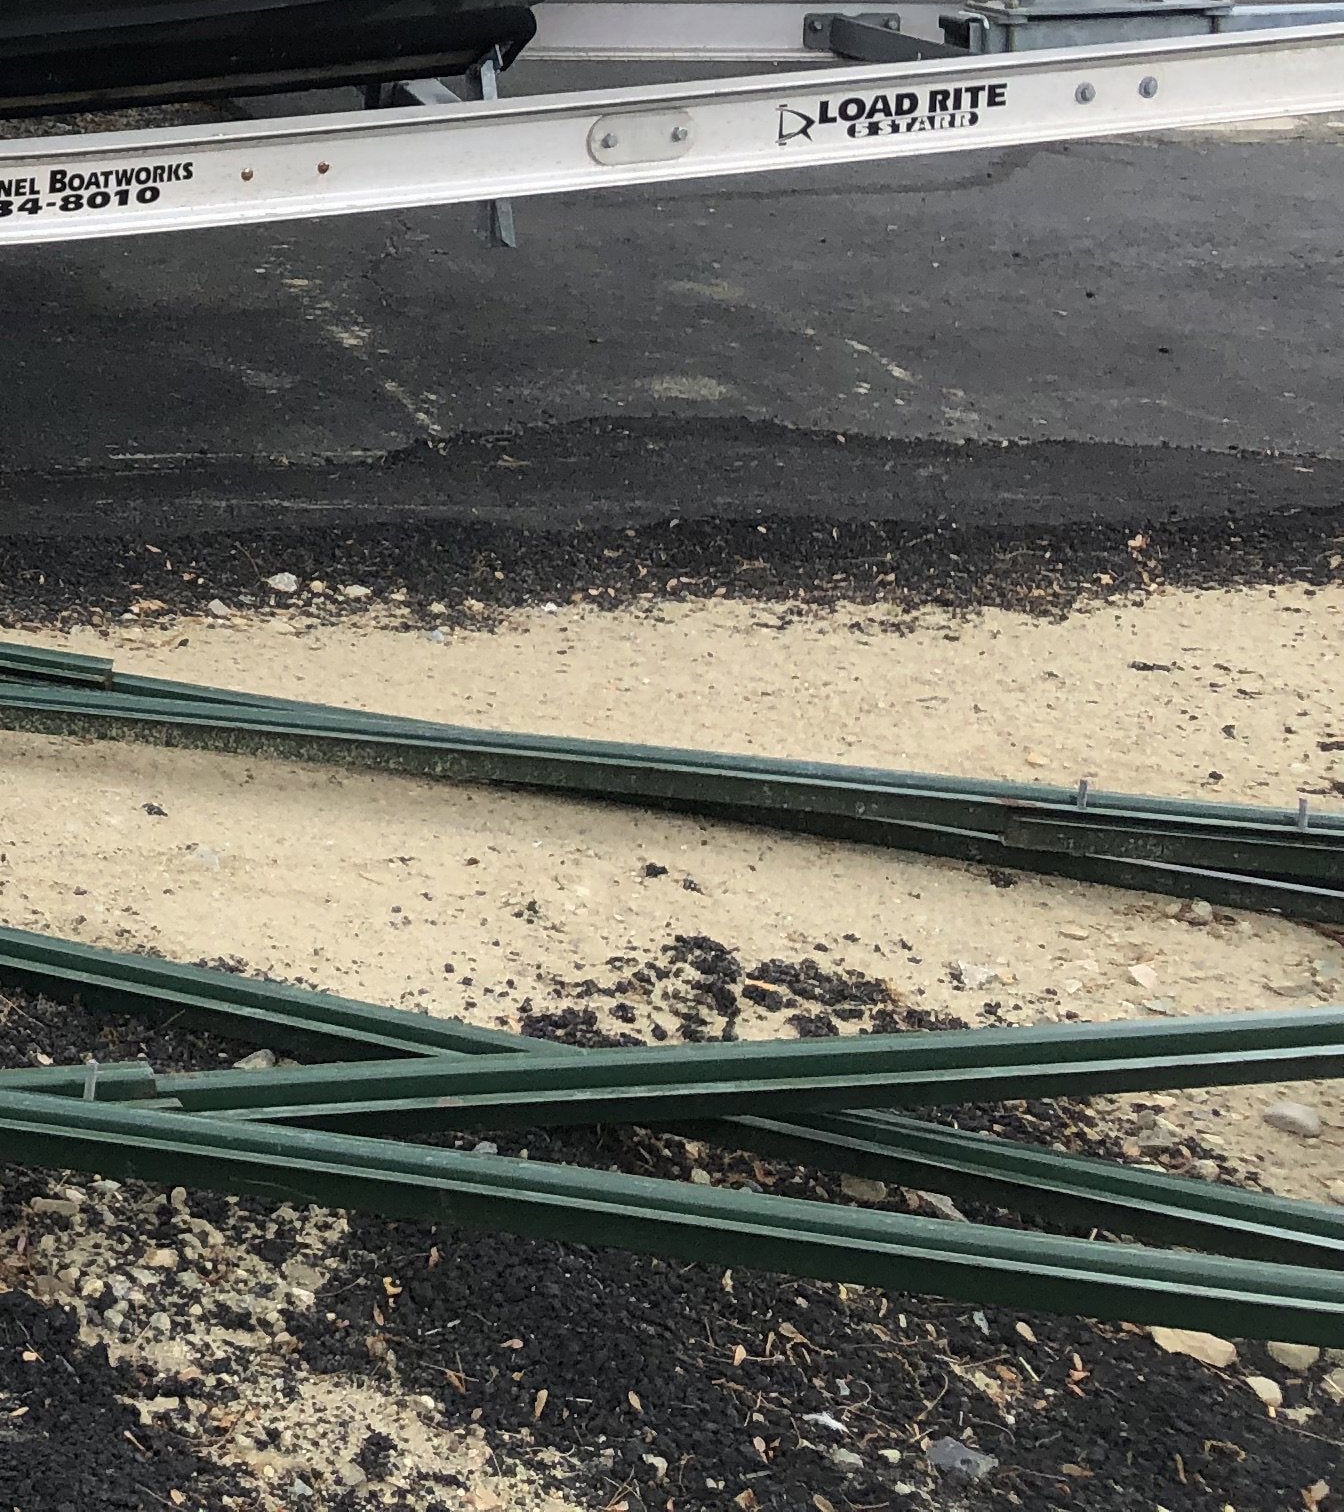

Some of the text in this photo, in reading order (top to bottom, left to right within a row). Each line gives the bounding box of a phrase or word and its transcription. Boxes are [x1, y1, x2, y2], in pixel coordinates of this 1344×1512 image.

[818, 83, 1008, 124] LOAD RITE
[49, 162, 194, 193] BOATWORKS
